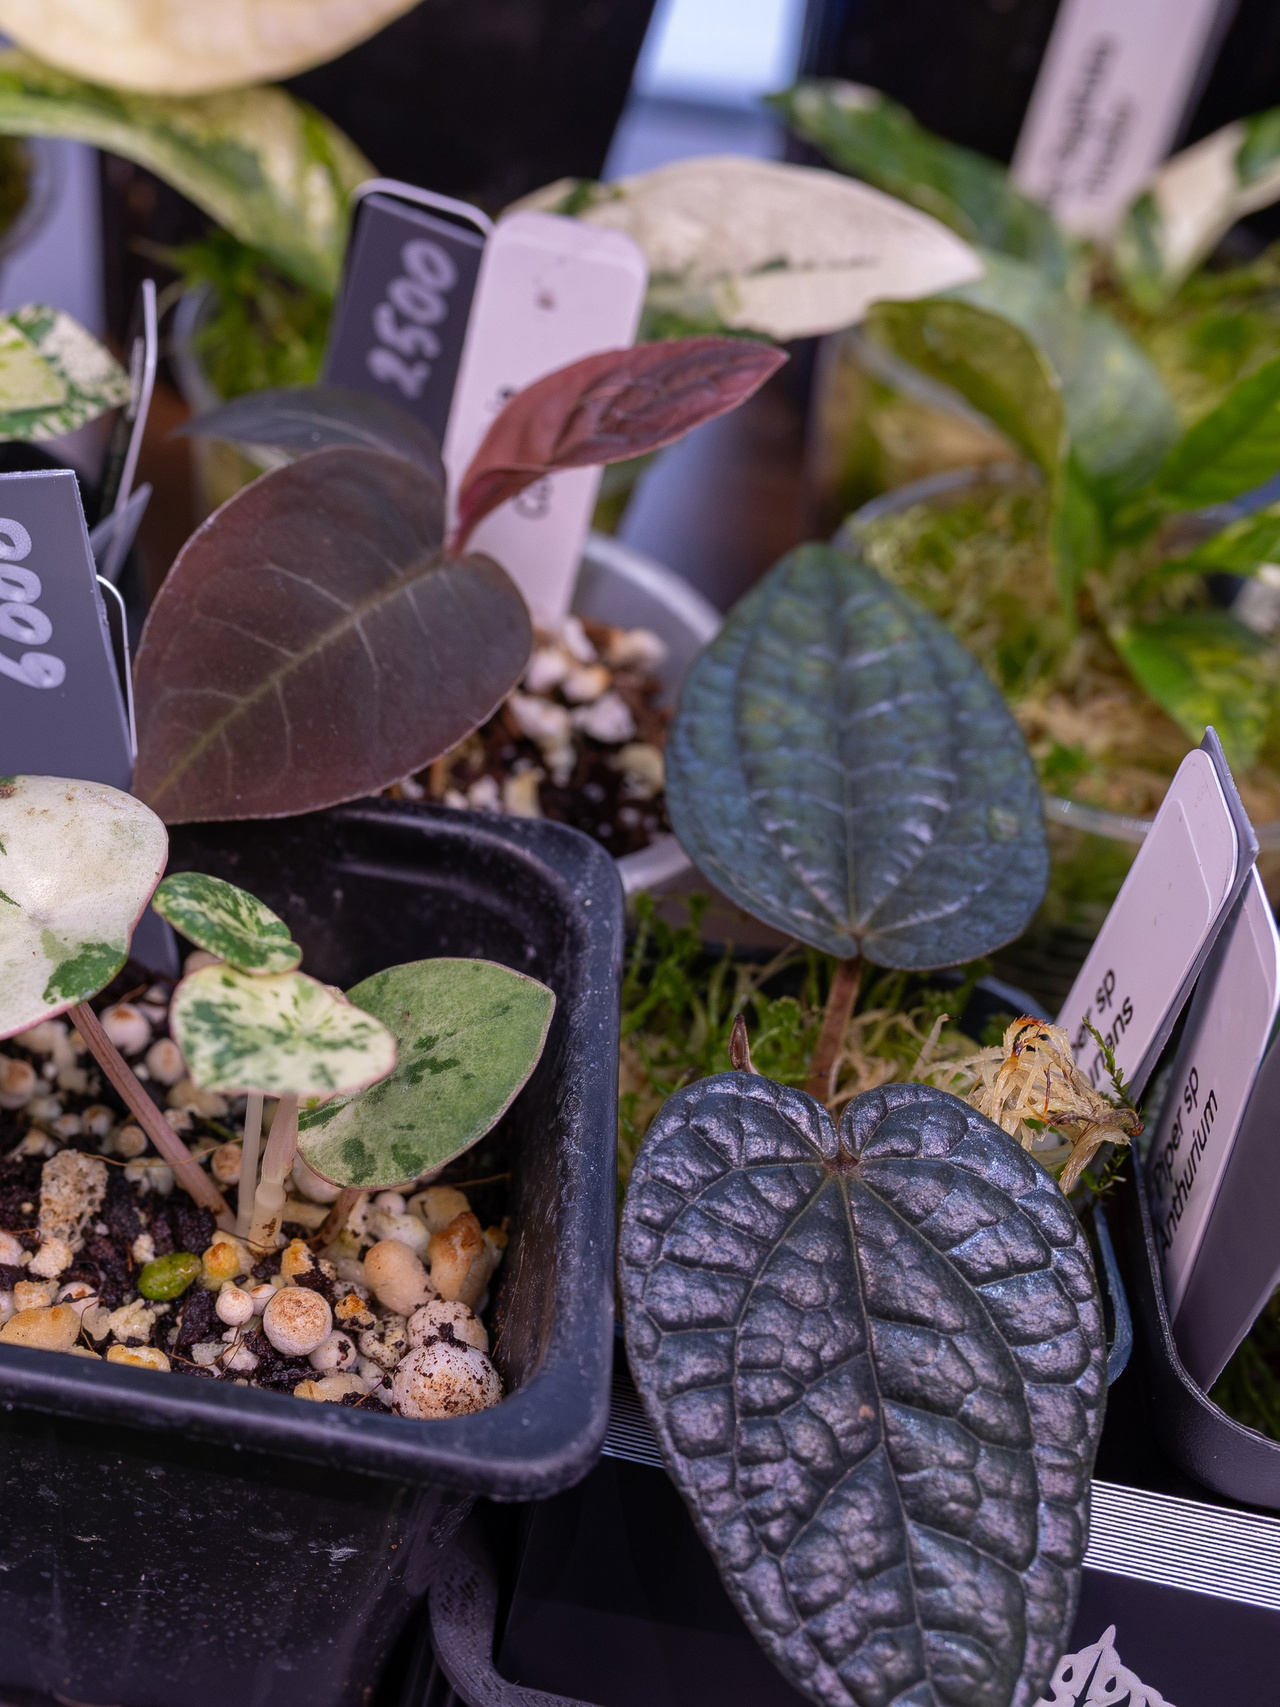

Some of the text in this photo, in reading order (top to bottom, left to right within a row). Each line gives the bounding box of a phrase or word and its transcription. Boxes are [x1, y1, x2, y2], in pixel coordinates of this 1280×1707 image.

[367, 239, 457, 397] 2500
[1096, 969, 1115, 1014] sp
[1184, 1066, 1199, 1114] sp
[1159, 1089, 1218, 1258] Anthurium
